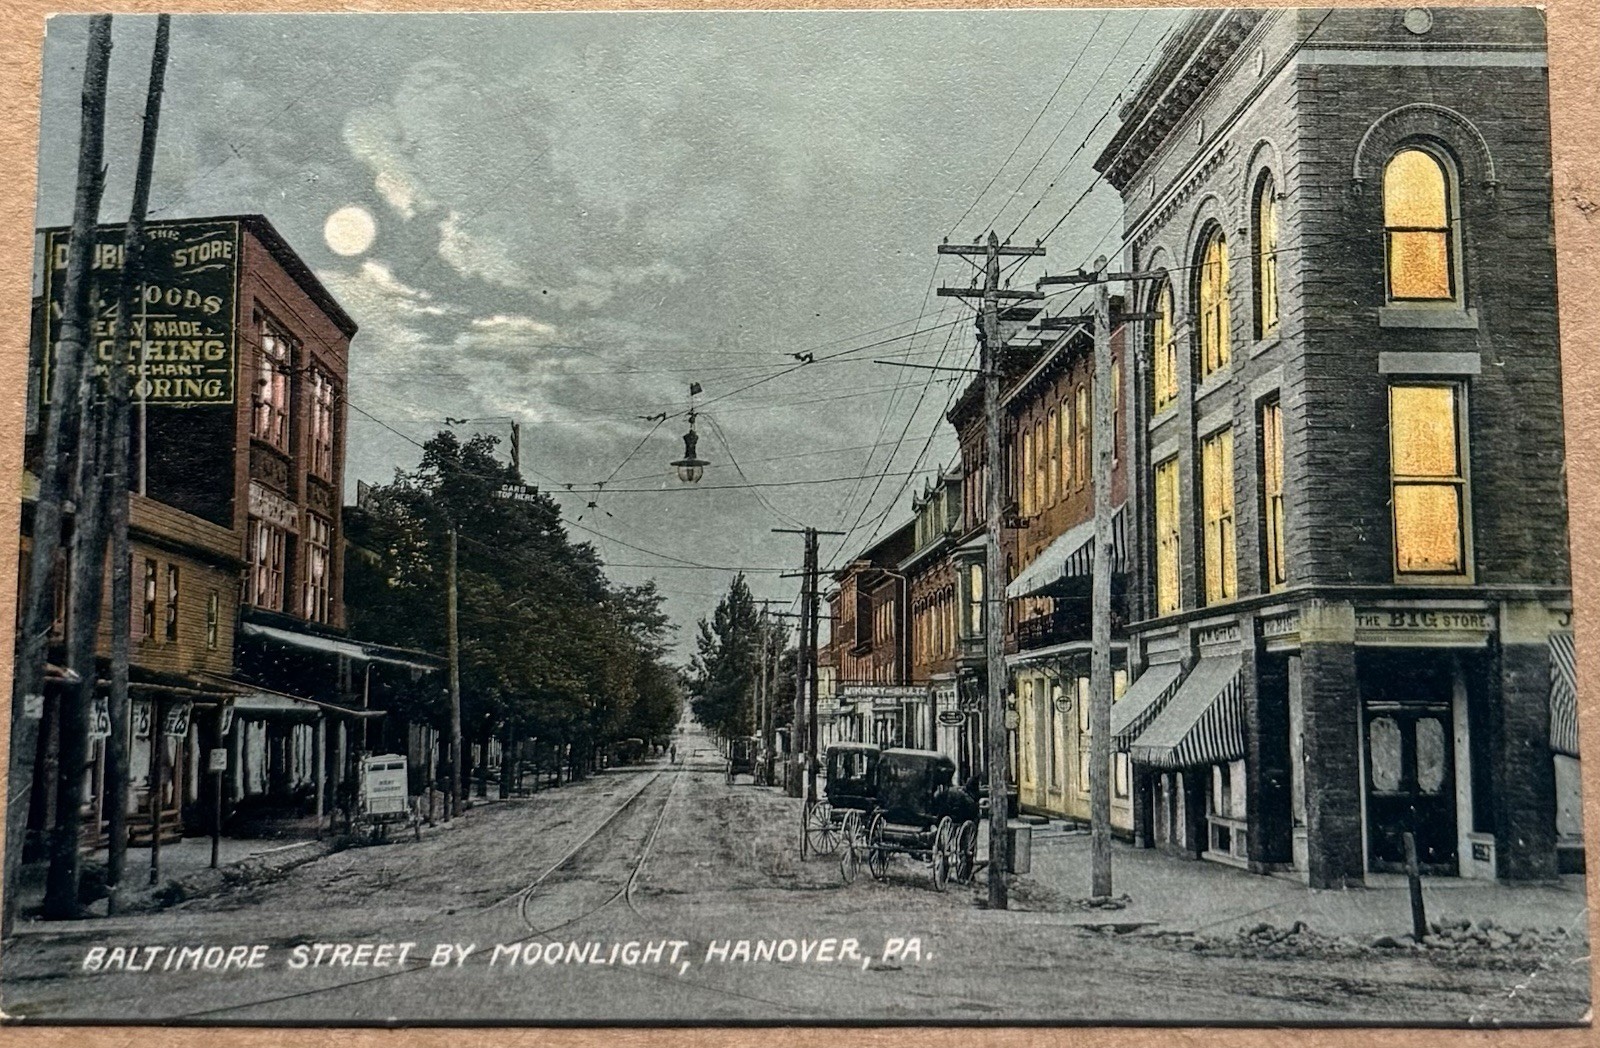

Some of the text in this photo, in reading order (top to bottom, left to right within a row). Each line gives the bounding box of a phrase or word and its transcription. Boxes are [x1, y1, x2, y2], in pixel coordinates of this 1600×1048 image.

[148, 229, 180, 241] THE
[173, 240, 233, 268] STORE
[133, 284, 224, 314] OODS
[98, 339, 228, 361] OTHING
[94, 364, 205, 376] MRCHANT
[1356, 614, 1380, 627] THE
[1387, 609, 1438, 628] BIG
